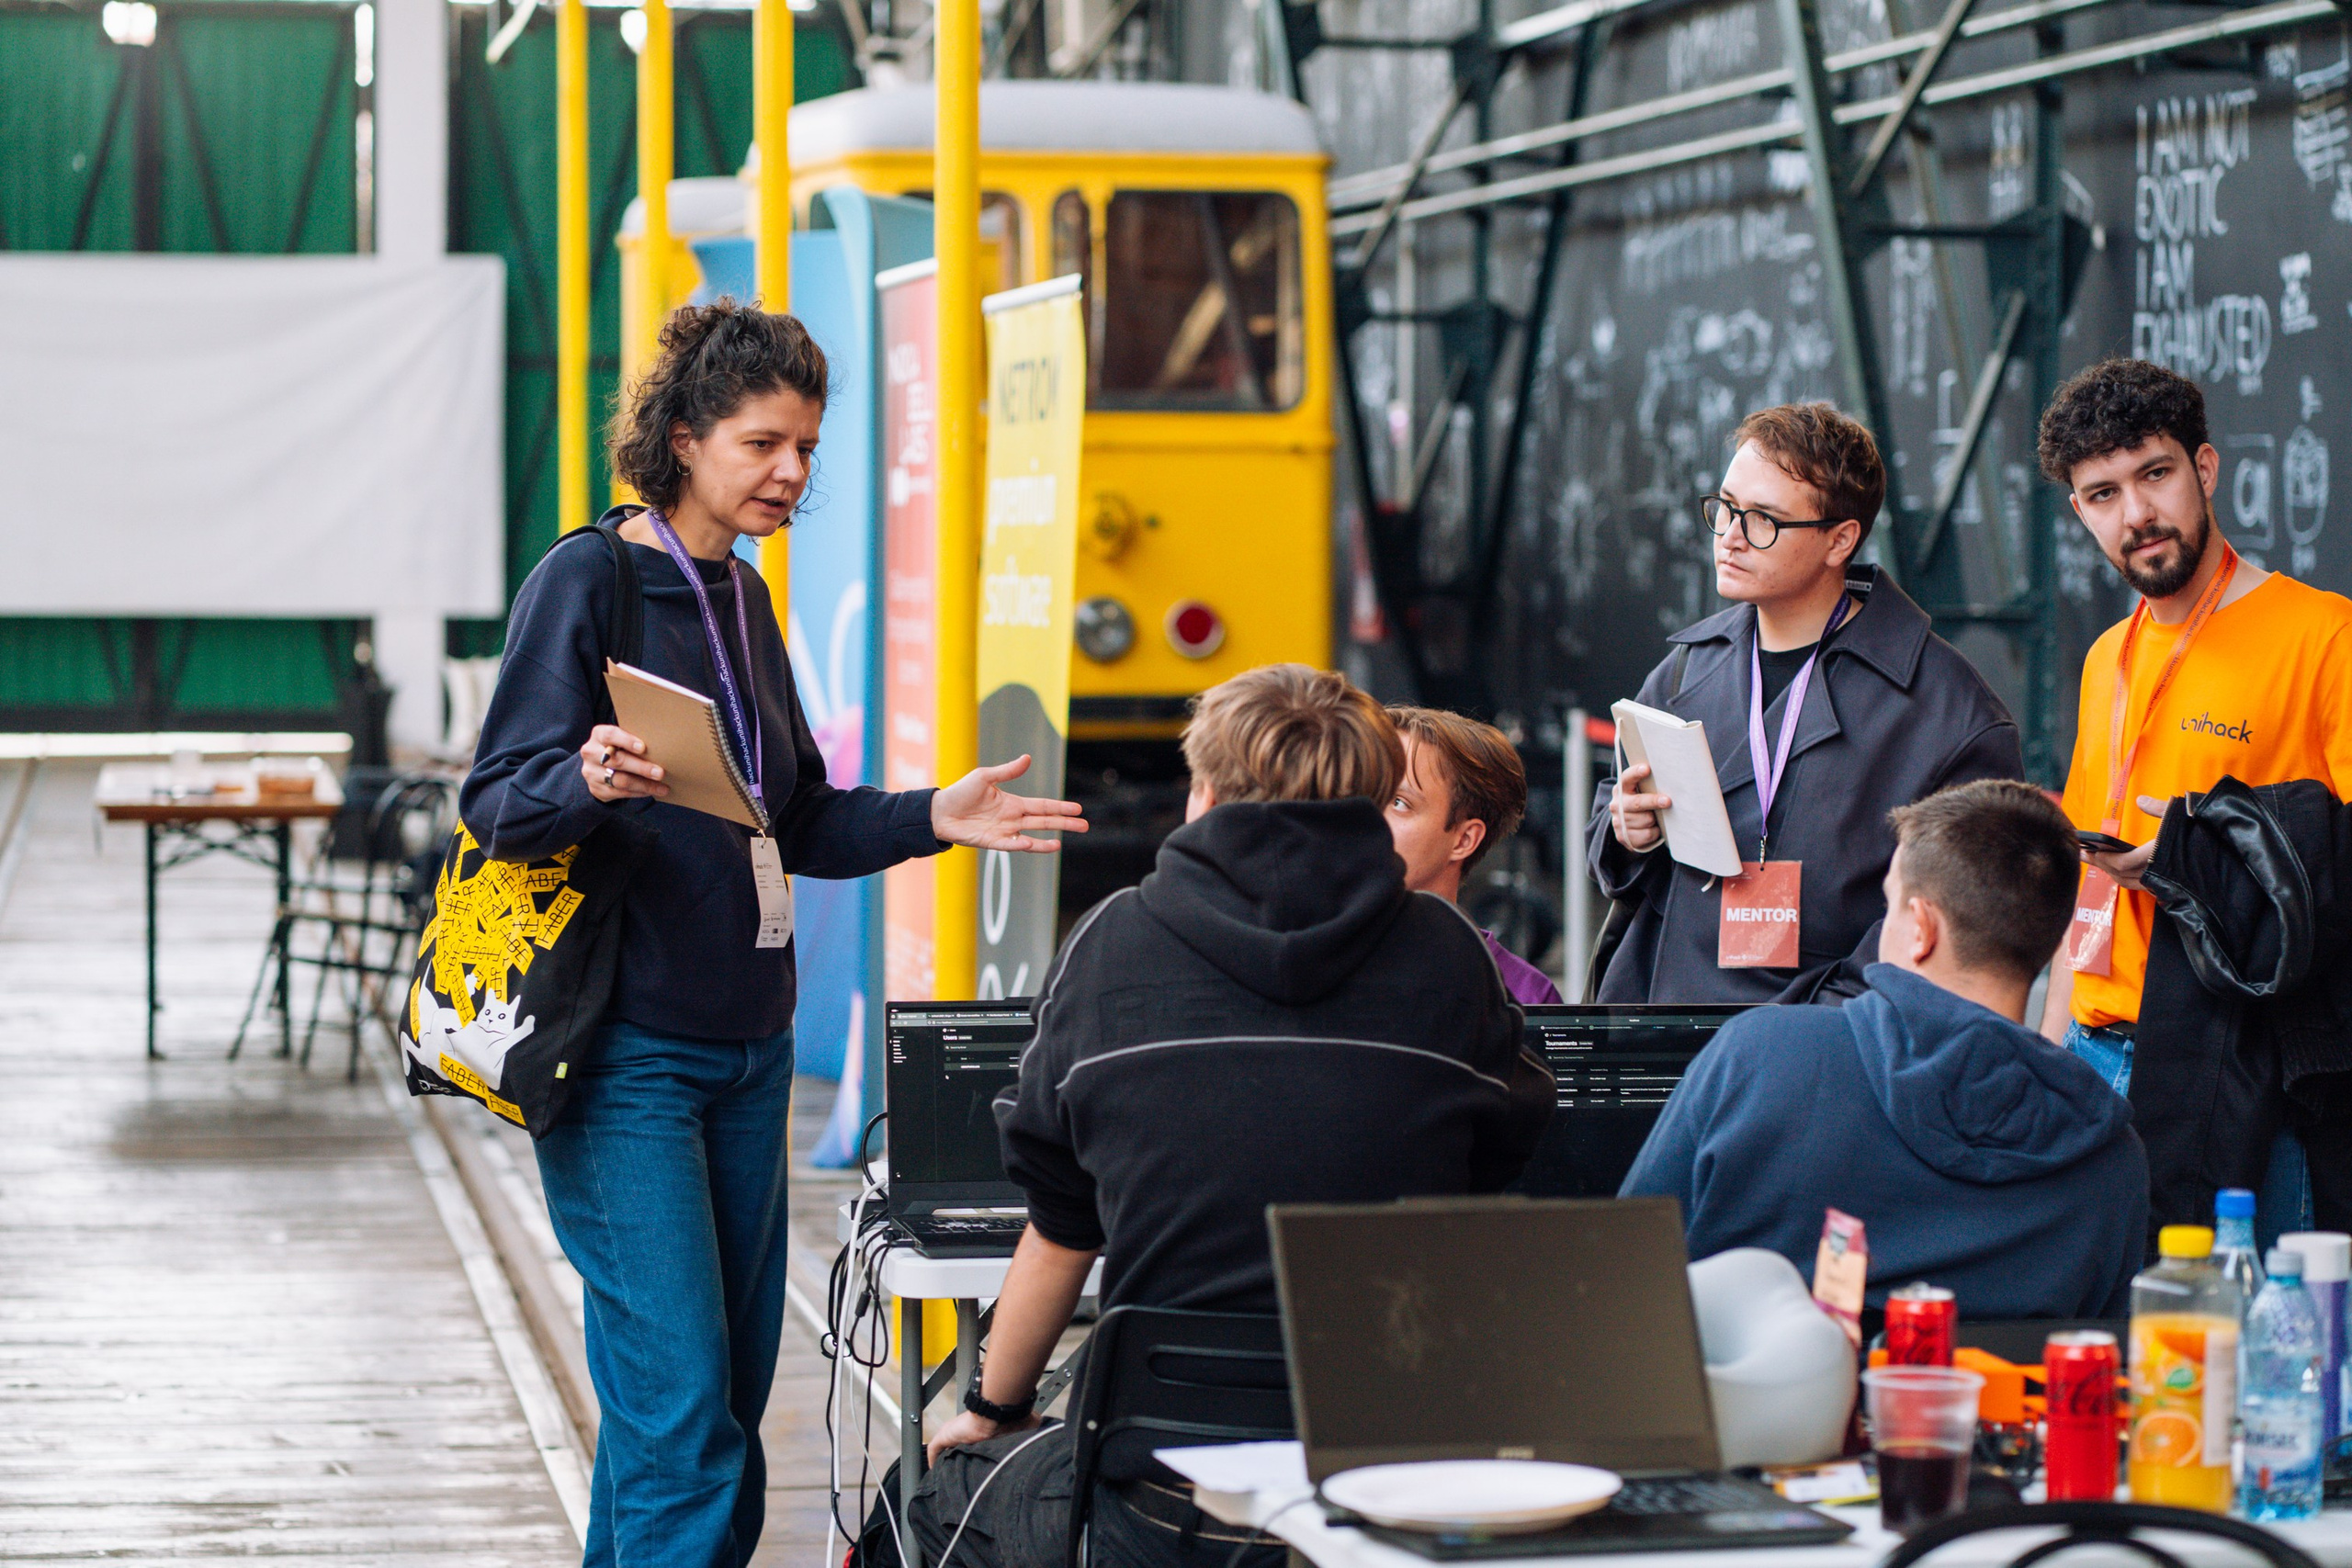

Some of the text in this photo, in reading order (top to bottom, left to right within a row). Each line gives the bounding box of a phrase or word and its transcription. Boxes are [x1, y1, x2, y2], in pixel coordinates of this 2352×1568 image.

[2206, 88, 2257, 169] NOT
[2135, 164, 2228, 243] EXOTIC
[2180, 711, 2254, 744] unihack
[538, 892, 579, 944] FABER
[1725, 908, 1798, 922] MENTOR
[2075, 907, 2113, 927] MENTOR
[441, 1057, 487, 1094] FABER
